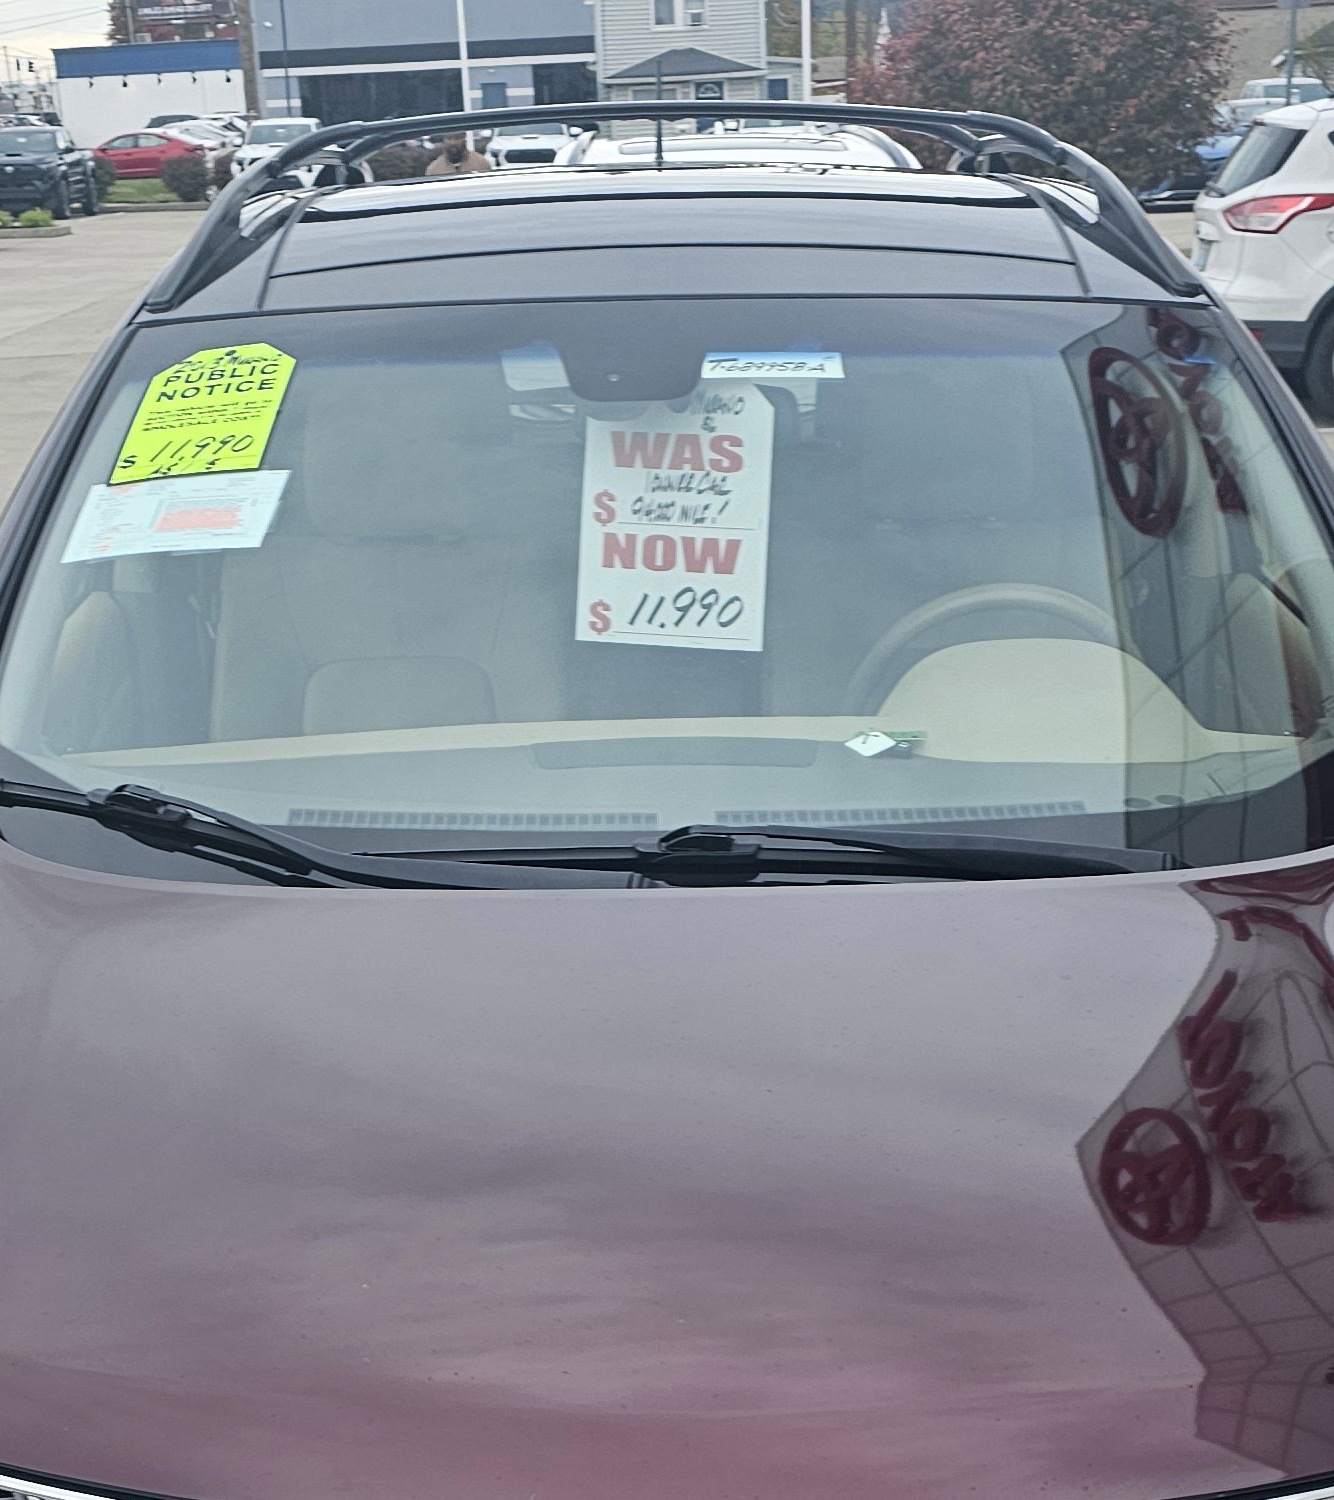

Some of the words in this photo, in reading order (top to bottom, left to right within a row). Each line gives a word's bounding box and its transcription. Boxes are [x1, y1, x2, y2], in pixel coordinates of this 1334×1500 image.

[156, 378, 276, 402] NOTICE
[163, 363, 280, 387] PUBLIC
[610, 430, 745, 474] WAS
[592, 488, 616, 527] $
[601, 531, 743, 575] NOW
[588, 599, 612, 635] $
